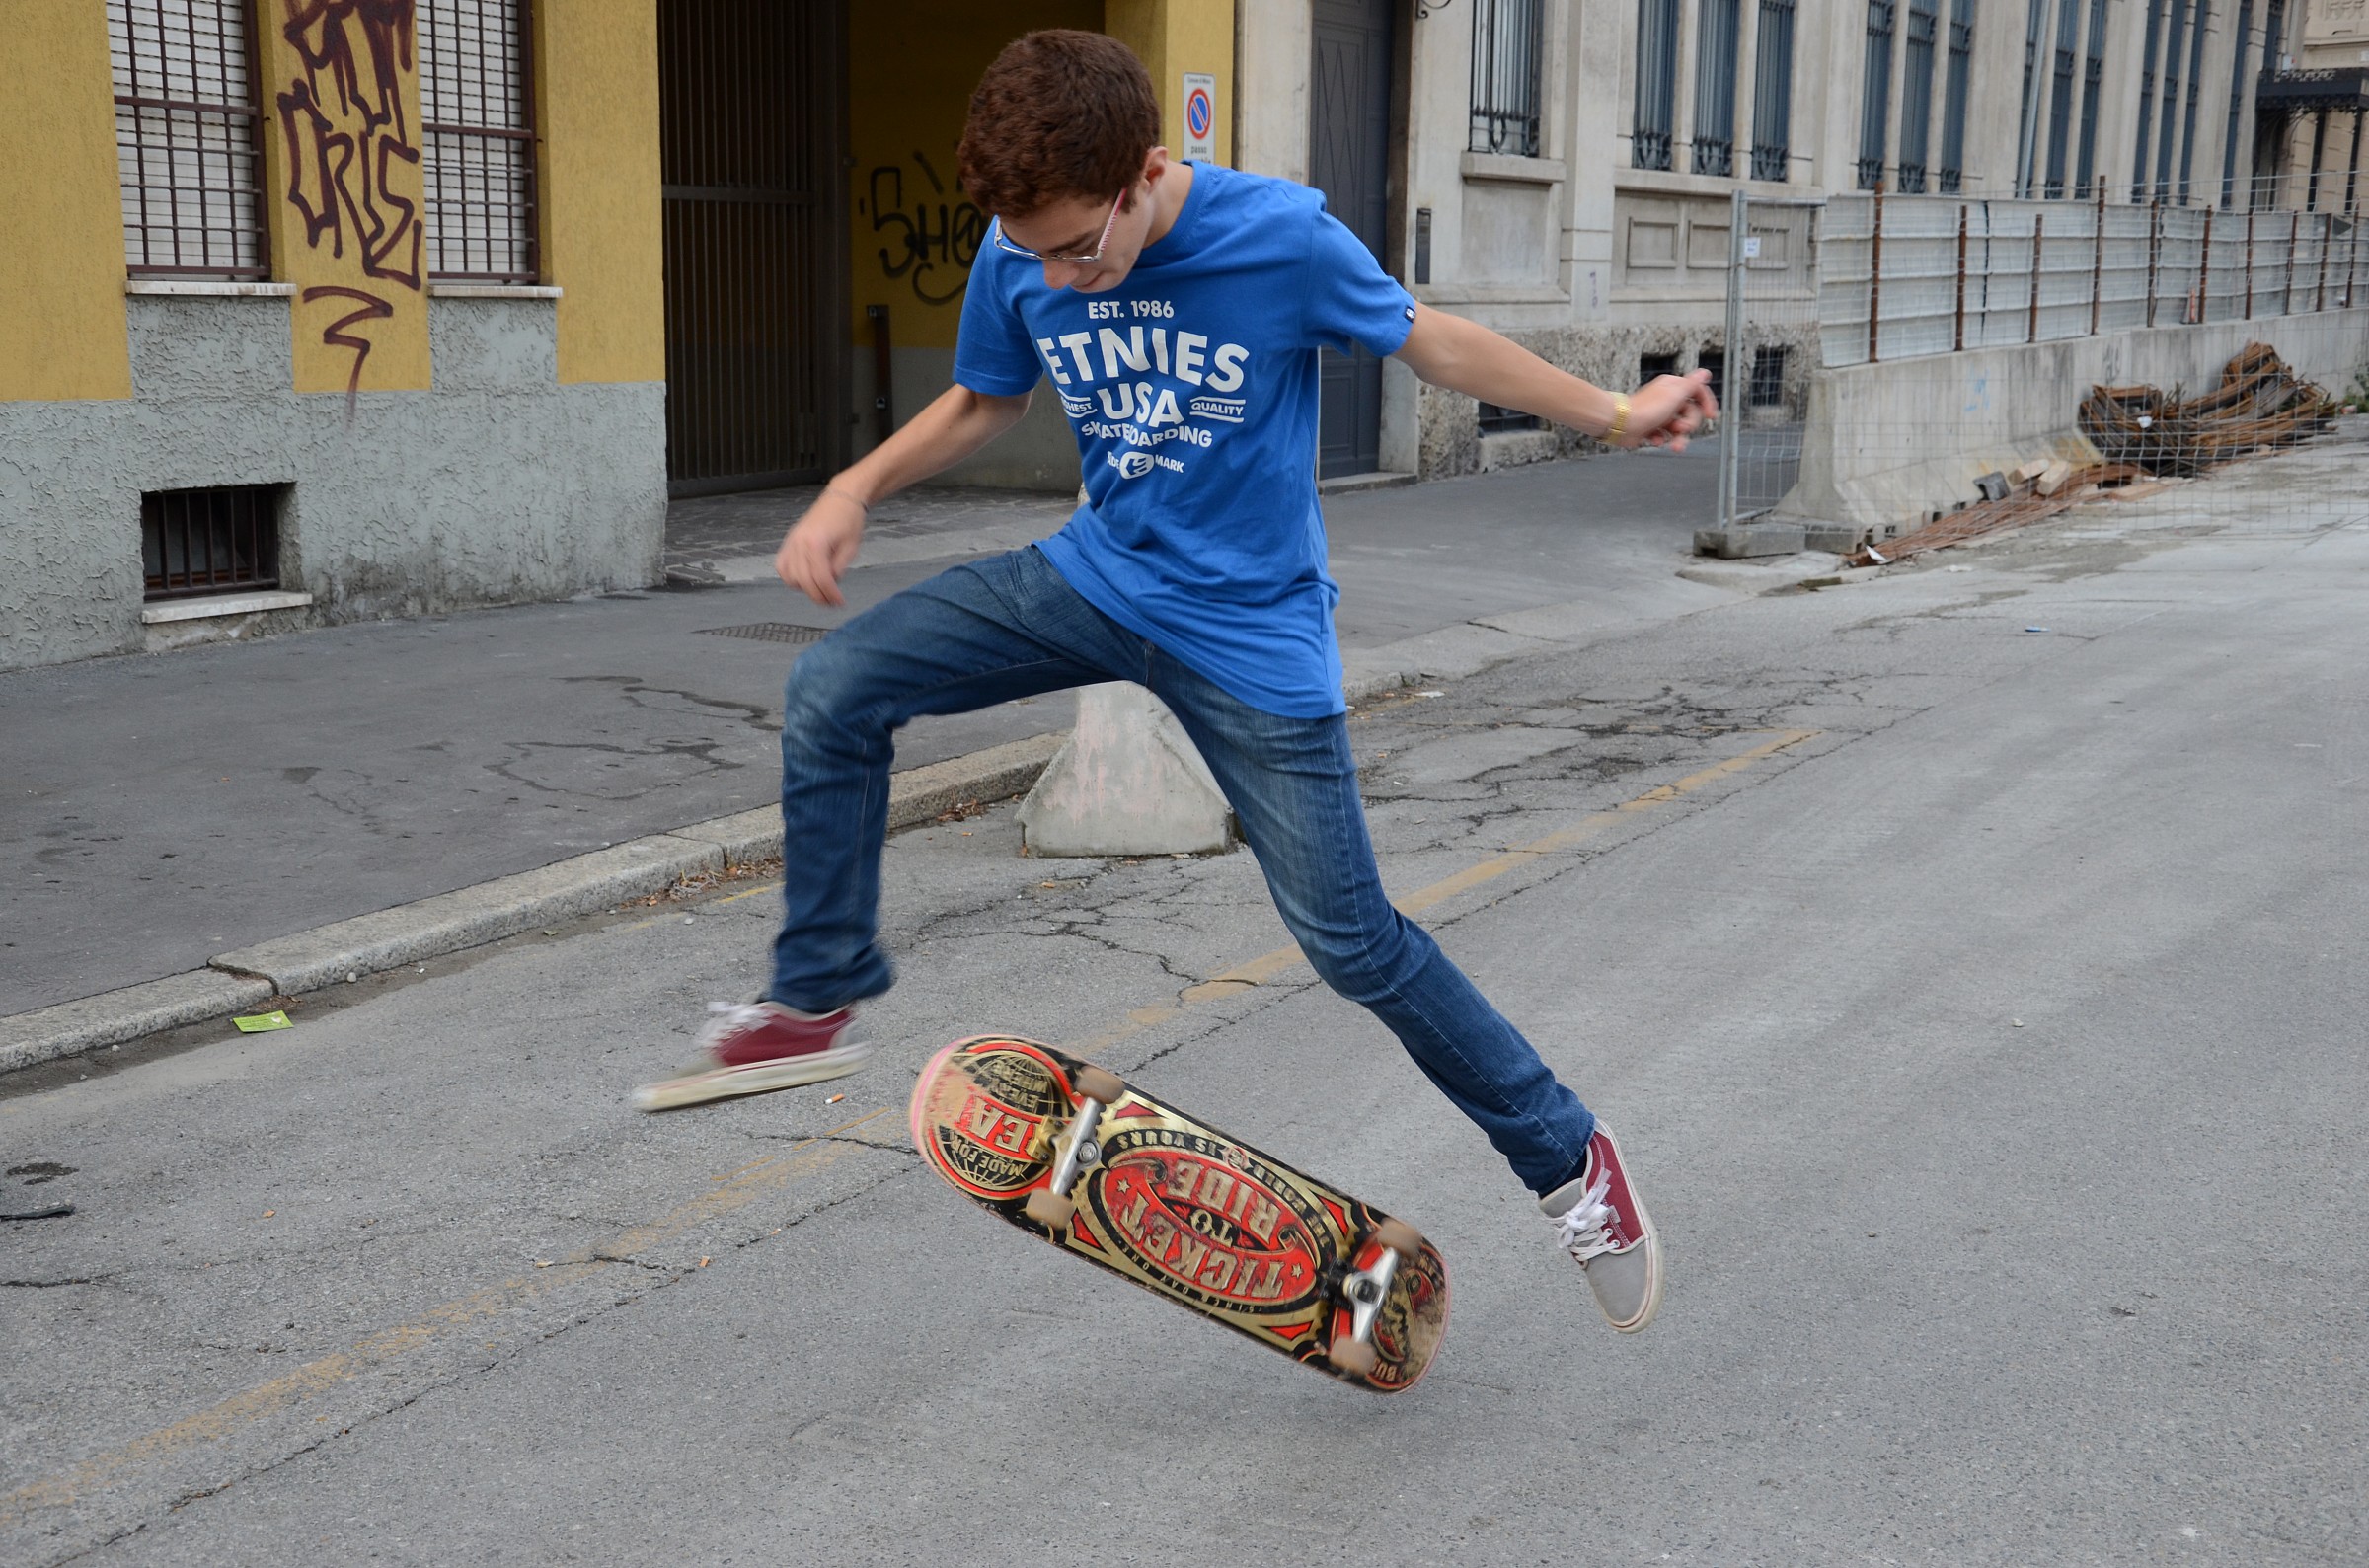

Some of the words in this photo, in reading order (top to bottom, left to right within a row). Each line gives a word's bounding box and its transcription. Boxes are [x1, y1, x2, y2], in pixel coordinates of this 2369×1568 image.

[1088, 301, 1125, 319] EST.
[1130, 300, 1175, 319] 1986
[1036, 325, 1250, 393] ETNIES
[1097, 381, 1184, 428] USA
[1191, 402, 1244, 416] QUALITY
[1081, 420, 1212, 448] SKATEOARDING
[1107, 450, 1120, 469] TADE
[1155, 454, 1184, 473] MARK
[952, 1134, 977, 1161] FOR
[1116, 1128, 1184, 1147] YOURS
[978, 1154, 1023, 1177] MADE
[1164, 1157, 1281, 1242] RIDE
[1187, 1207, 1234, 1247] TO
[1118, 1190, 1285, 1298] TICKET
[1121, 1243, 1149, 1269] ONE
[1159, 1273, 1189, 1293] DAY
